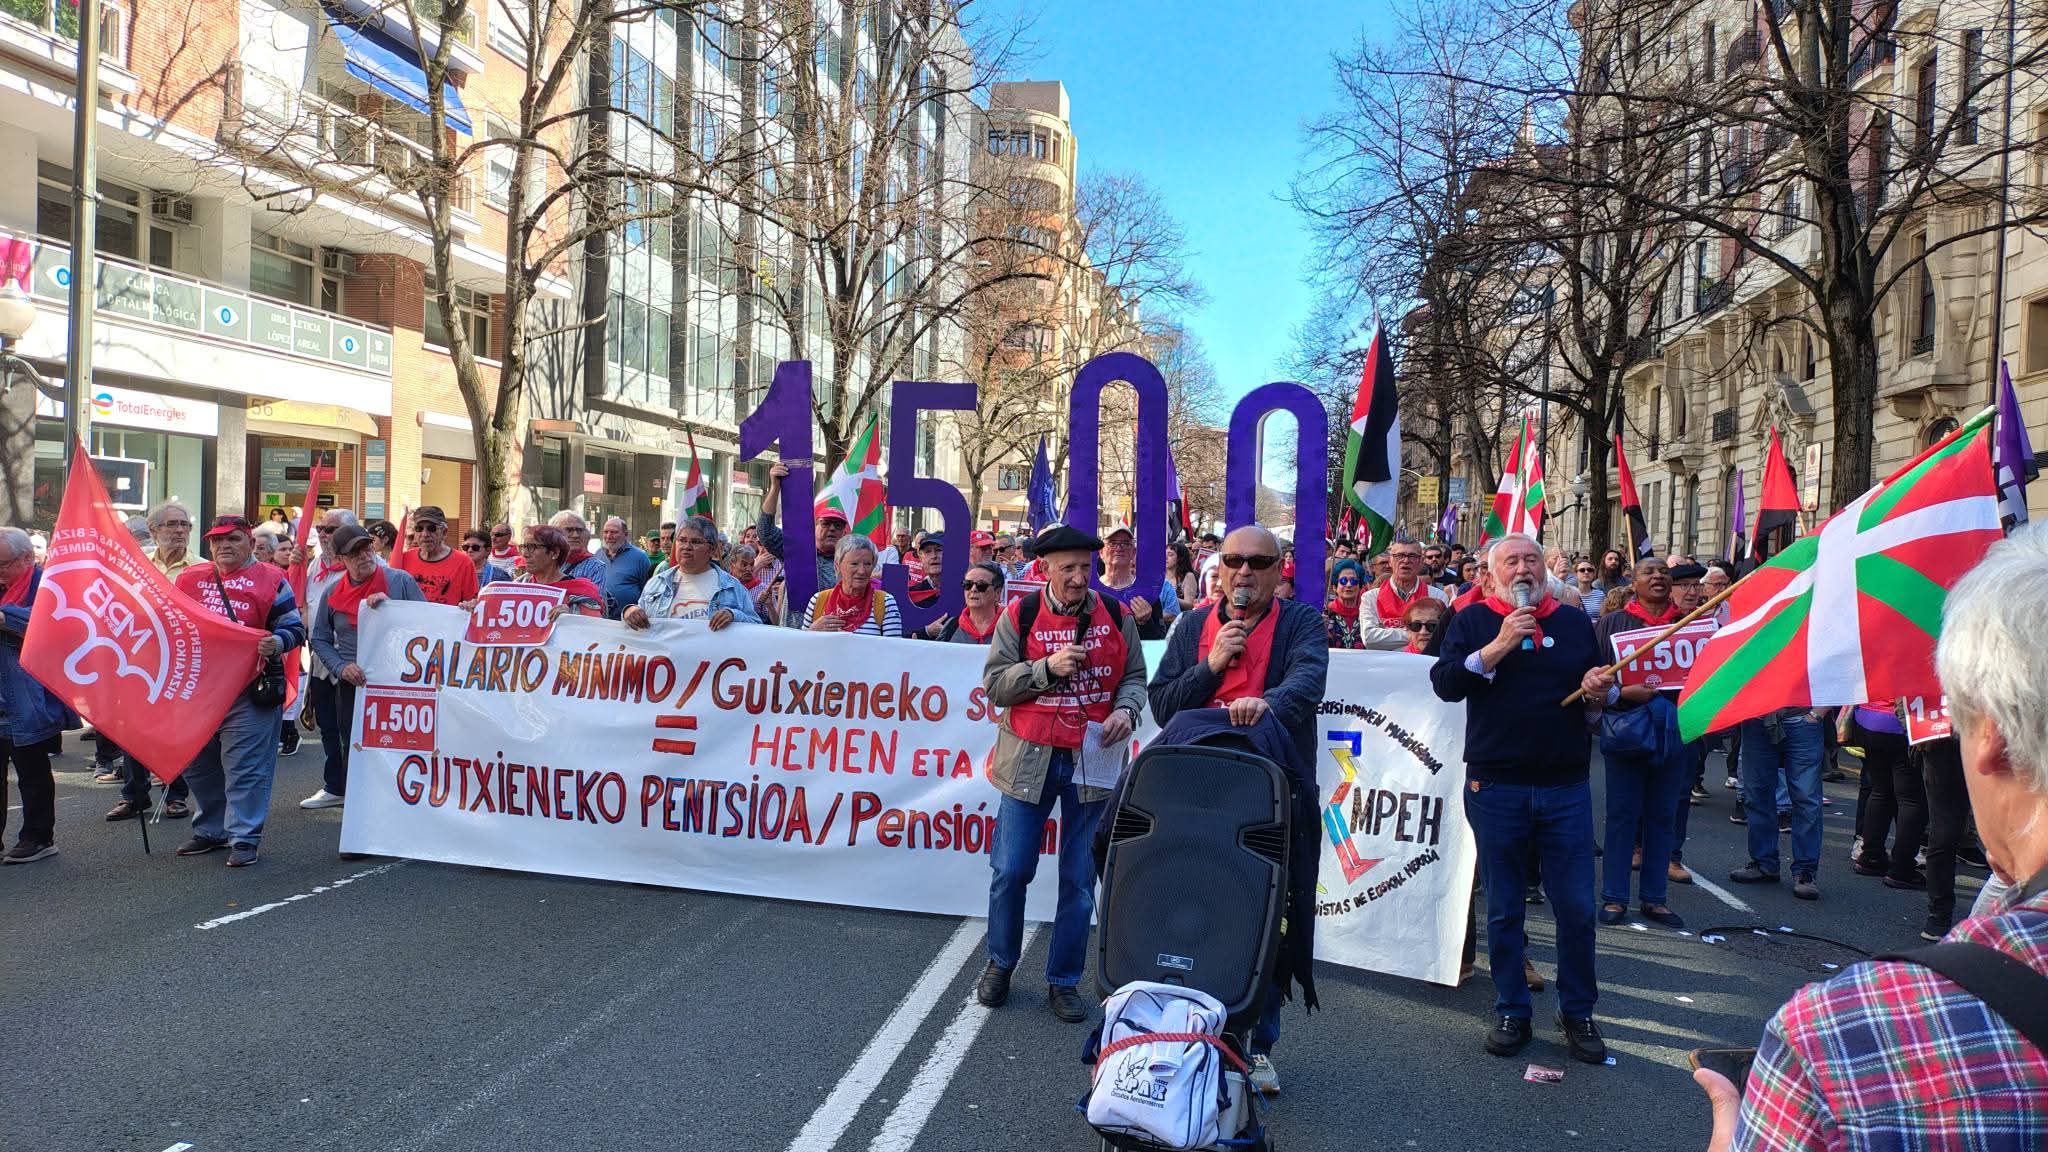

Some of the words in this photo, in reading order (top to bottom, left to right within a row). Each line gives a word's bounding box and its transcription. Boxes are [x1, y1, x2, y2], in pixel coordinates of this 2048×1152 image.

[127, 276, 170, 297] CLÍNCA
[116, 401, 188, 421] TotalEnergies
[251, 398, 273, 416] 56
[473, 599, 553, 628] 1.500
[1034, 625, 1111, 641] GUTXIEKO
[401, 635, 548, 693] SALARIO
[552, 642, 676, 703] MÍNIMO
[712, 657, 948, 722] Gutxieneko
[366, 702, 434, 734] 1.500
[750, 722, 898, 775] HEMEN
[911, 748, 974, 779] ETA
[397, 750, 627, 825] GUTXIENEKO
[640, 773, 813, 844] PENTSIOA
[848, 790, 996, 855] Pensión
[1350, 786, 1443, 846] MPEH
[1353, 892, 1368, 908] DE
